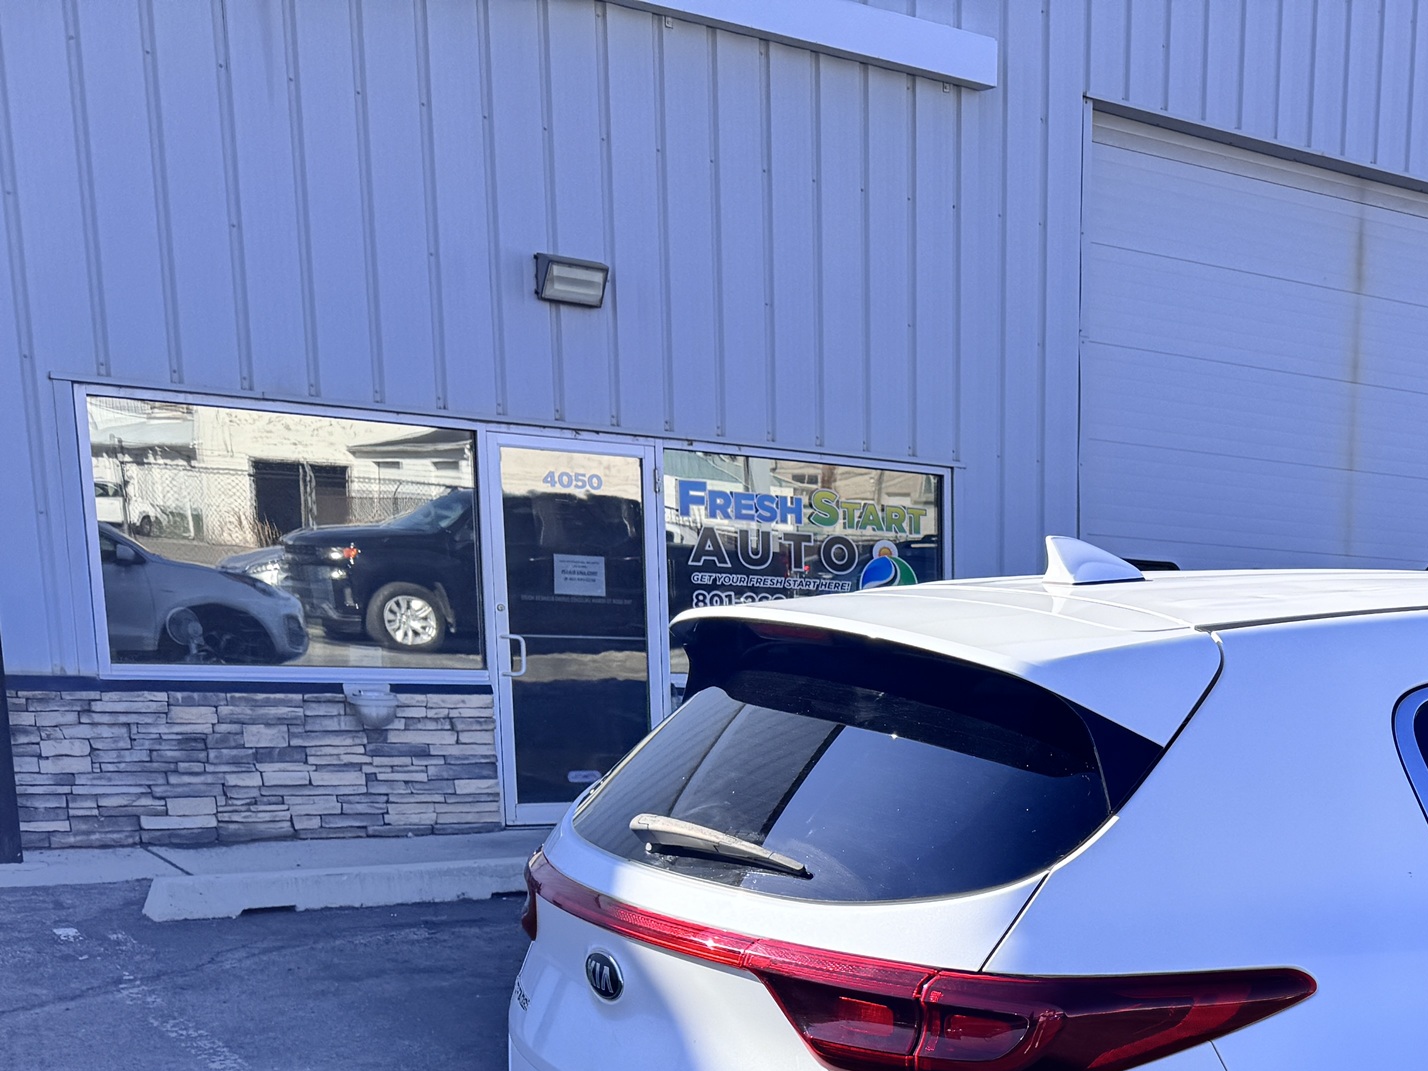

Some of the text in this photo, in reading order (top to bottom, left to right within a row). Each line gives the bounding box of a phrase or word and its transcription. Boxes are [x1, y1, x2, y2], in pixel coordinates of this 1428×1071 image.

[542, 470, 603, 491] 4050
[678, 479, 928, 536] FRESH START
[688, 525, 859, 576] AUTO
[691, 572, 852, 592] GET YOUR FRESH START HERE!
[587, 957, 615, 994] KIA
